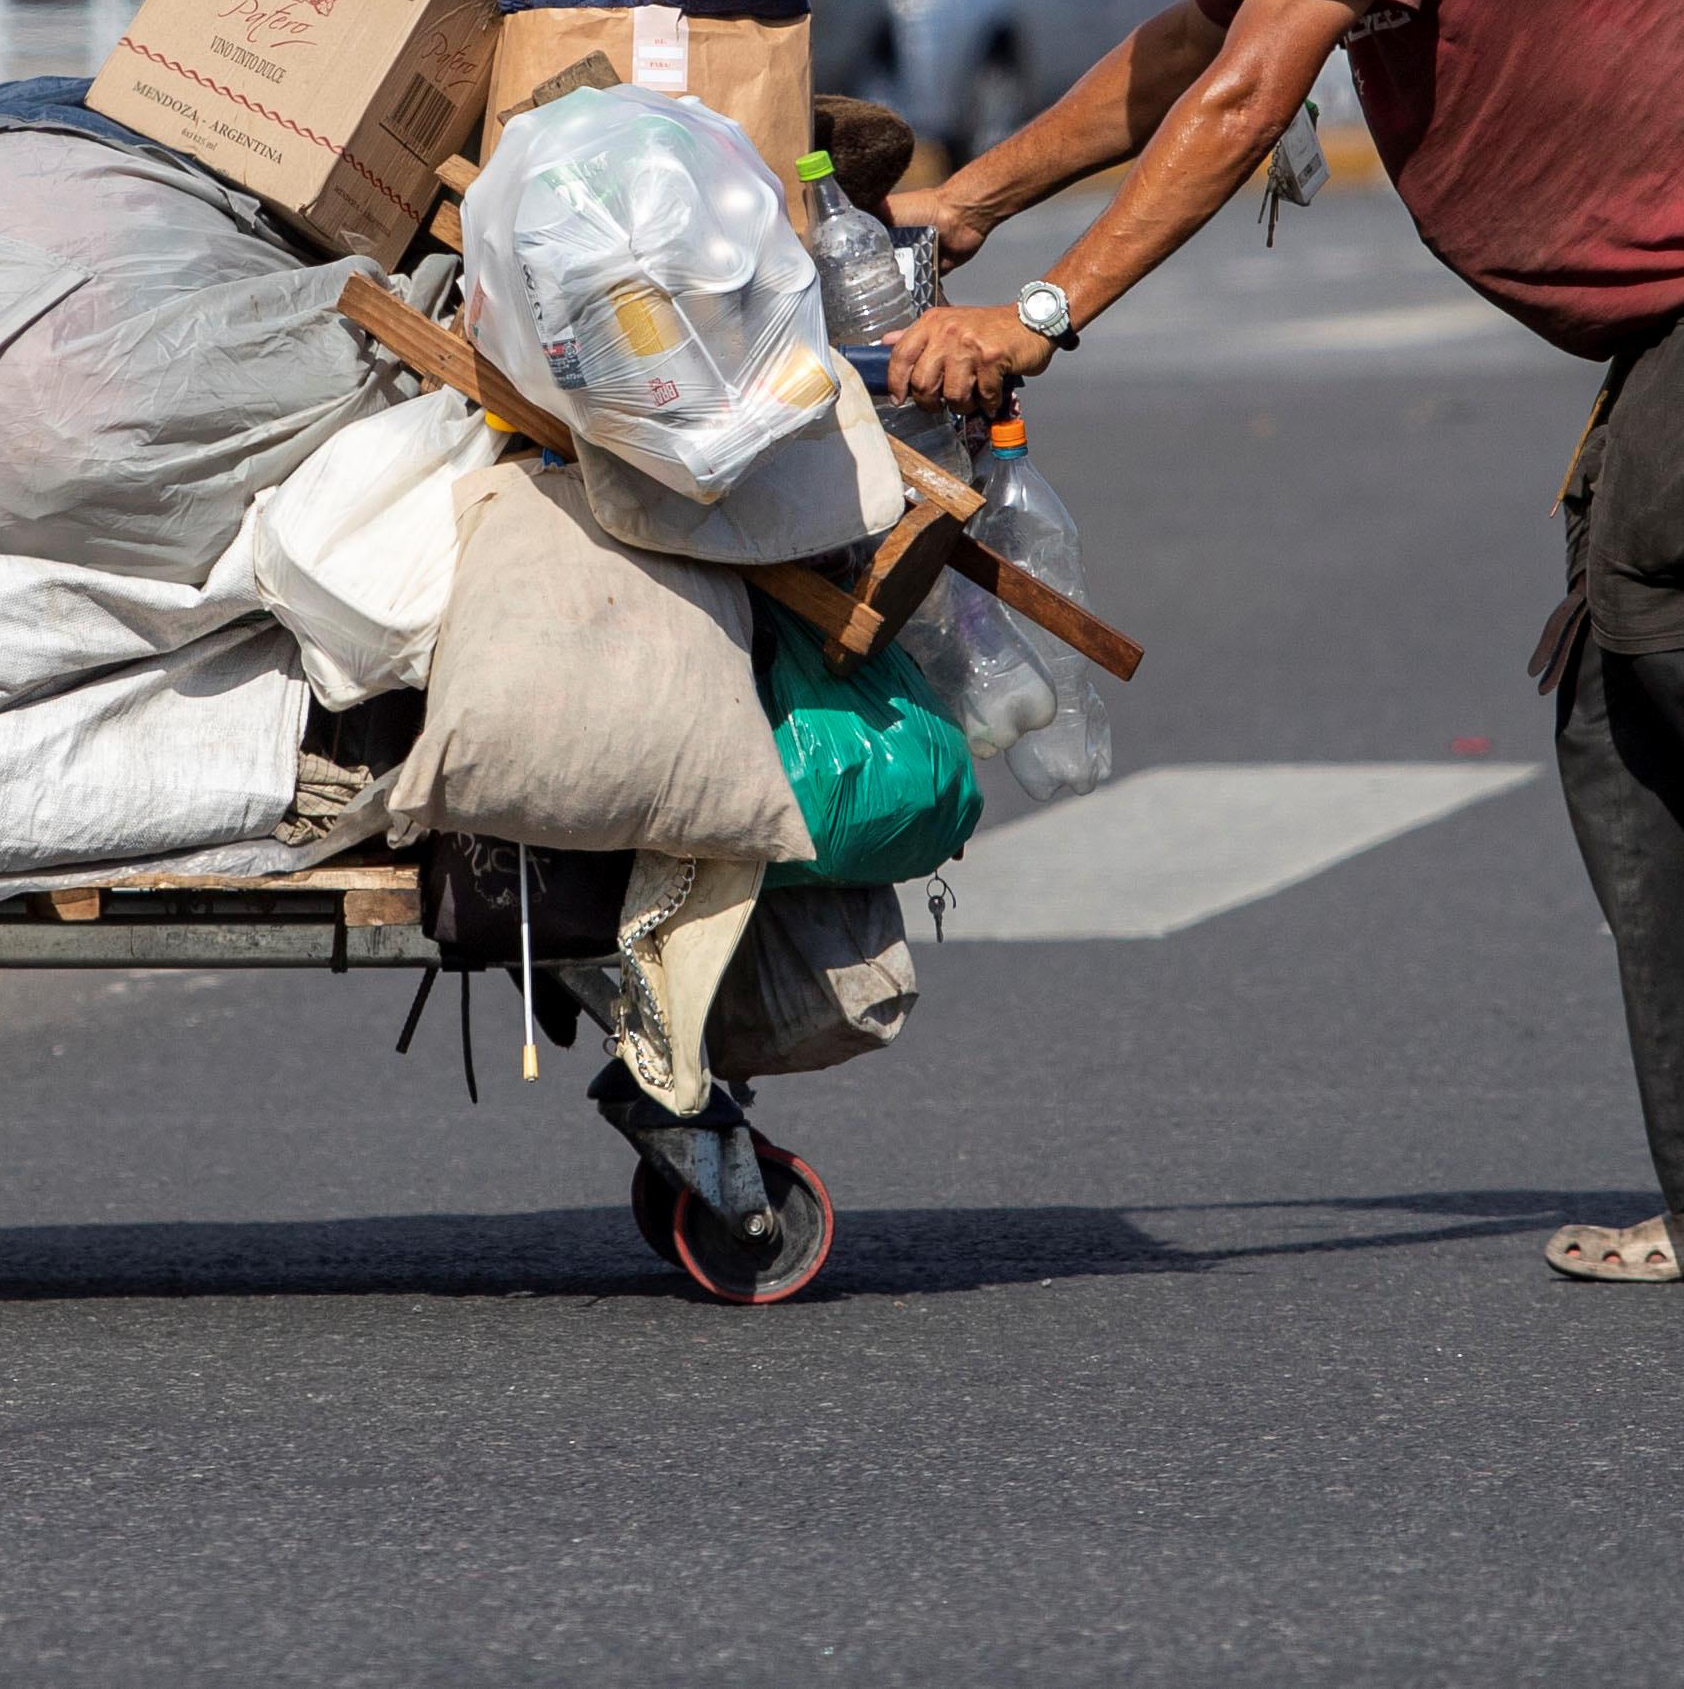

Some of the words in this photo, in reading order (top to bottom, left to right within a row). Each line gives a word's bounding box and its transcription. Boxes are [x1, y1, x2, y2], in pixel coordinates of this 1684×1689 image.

[210, 35, 235, 59] VINO
[231, 46, 259, 71] TINTO
[256, 59, 287, 84] DULCE
[132, 81, 199, 122] MENDOZA
[209, 121, 283, 165] ARGENTINA
